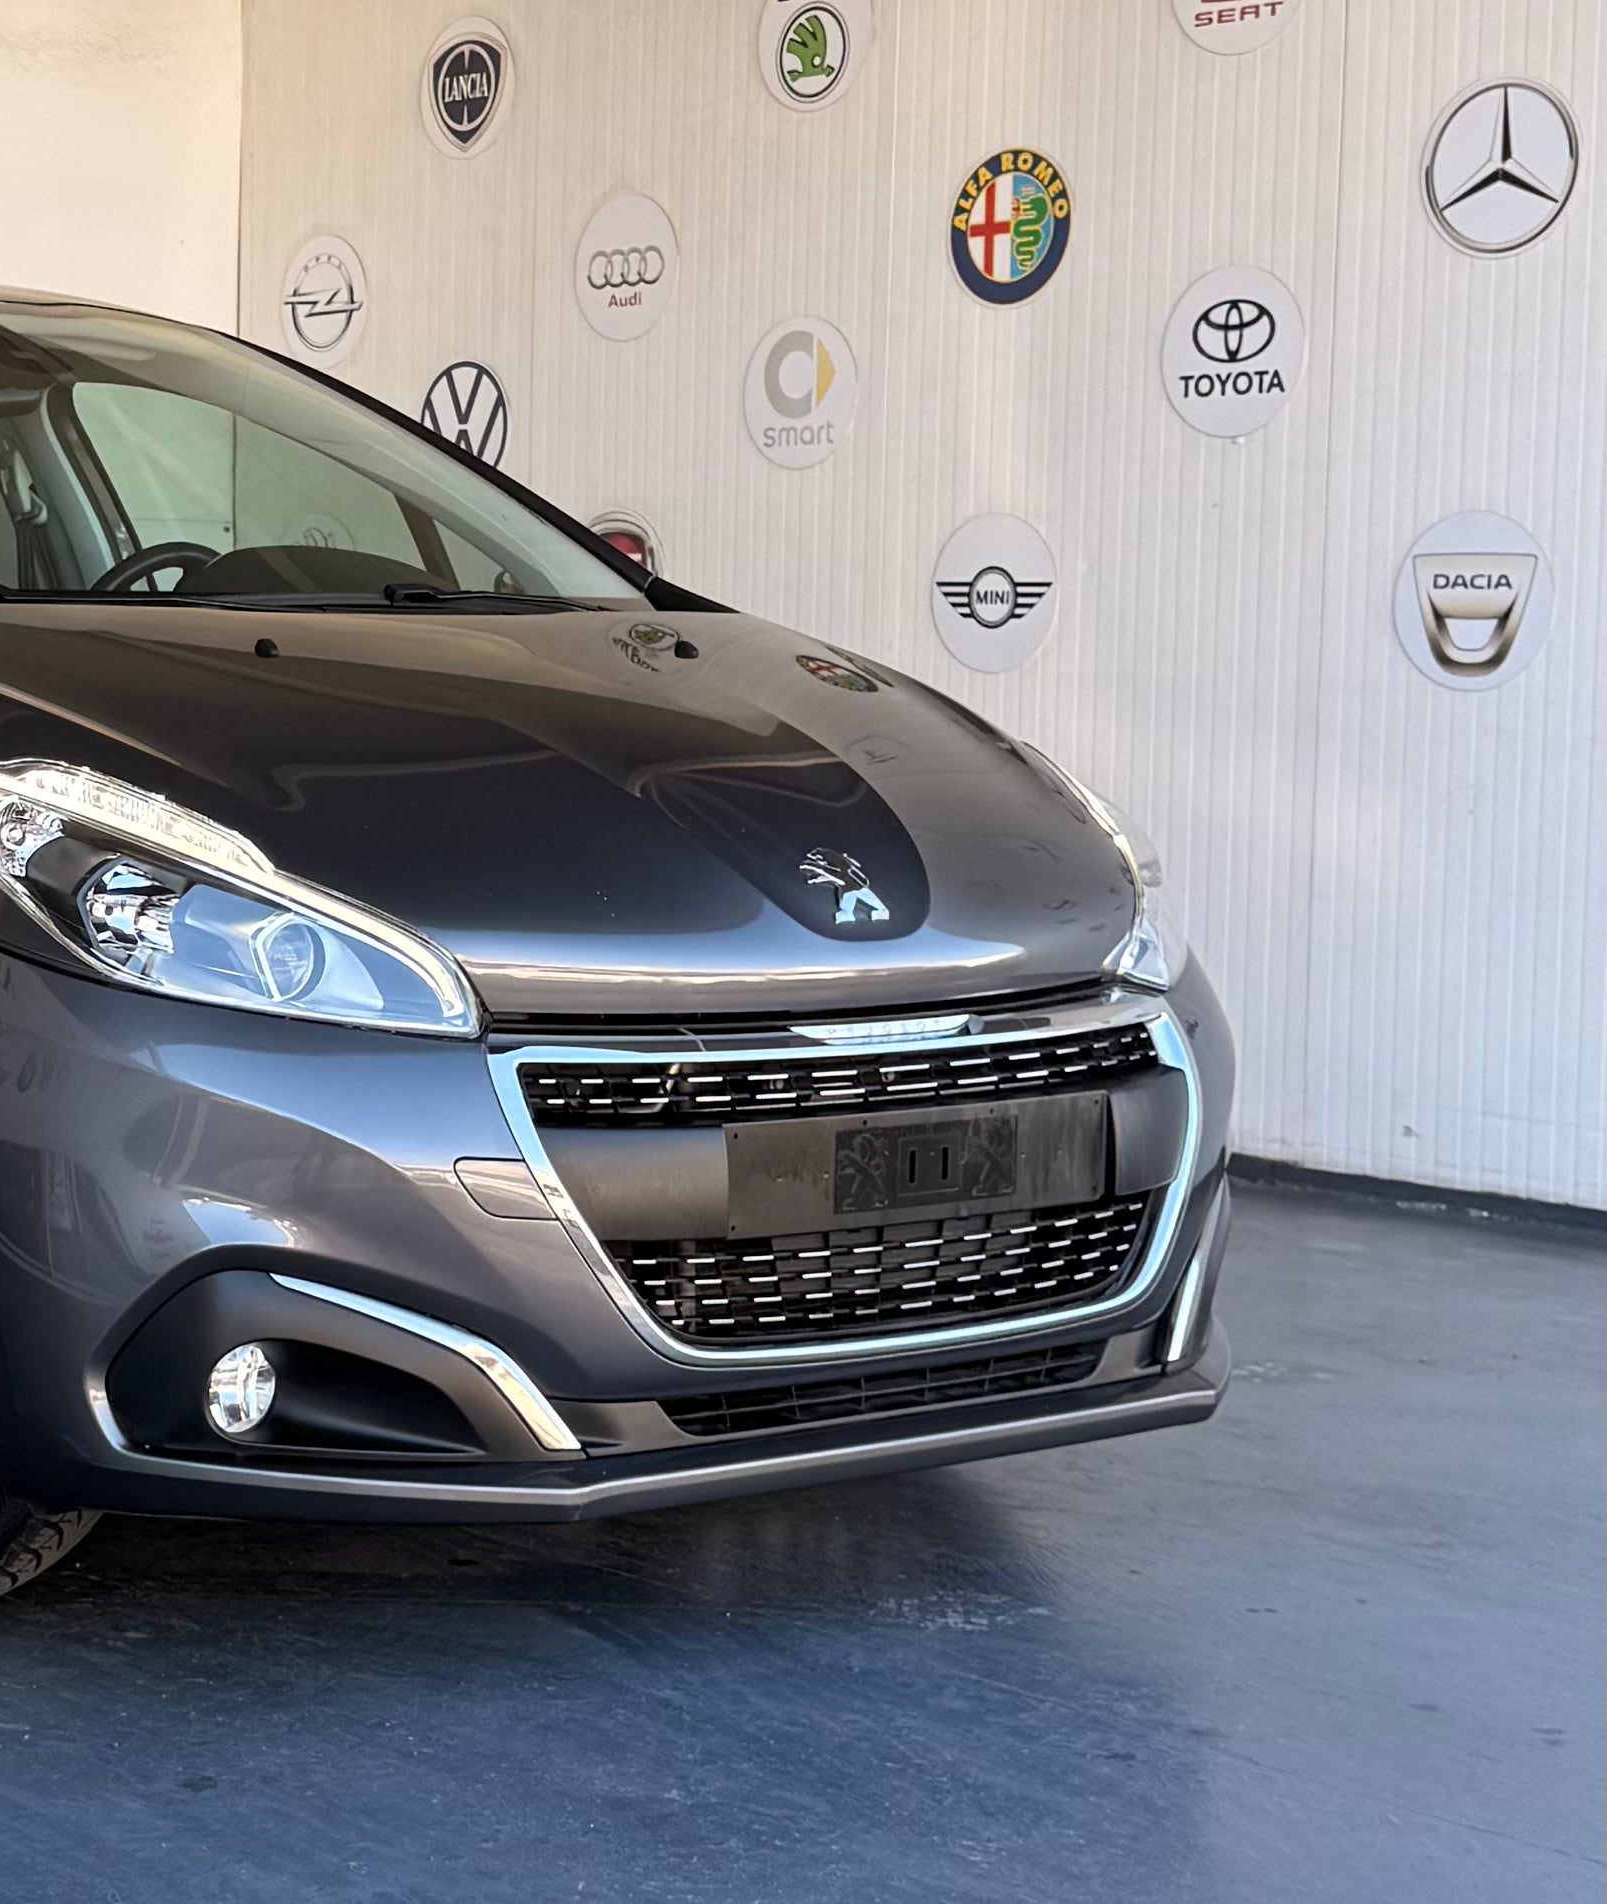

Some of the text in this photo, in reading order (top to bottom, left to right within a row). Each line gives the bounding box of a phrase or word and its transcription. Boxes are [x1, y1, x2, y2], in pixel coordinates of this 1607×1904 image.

[1194, 1, 1284, 28] SEAT
[443, 71, 489, 103] LANCIA
[953, 151, 1070, 233] ALFA ROMEO
[607, 291, 643, 308] Audi
[1179, 369, 1286, 399] TOYOTA
[762, 422, 835, 449] smart
[1433, 573, 1513, 591] DACIA
[975, 590, 1011, 606] MINI
